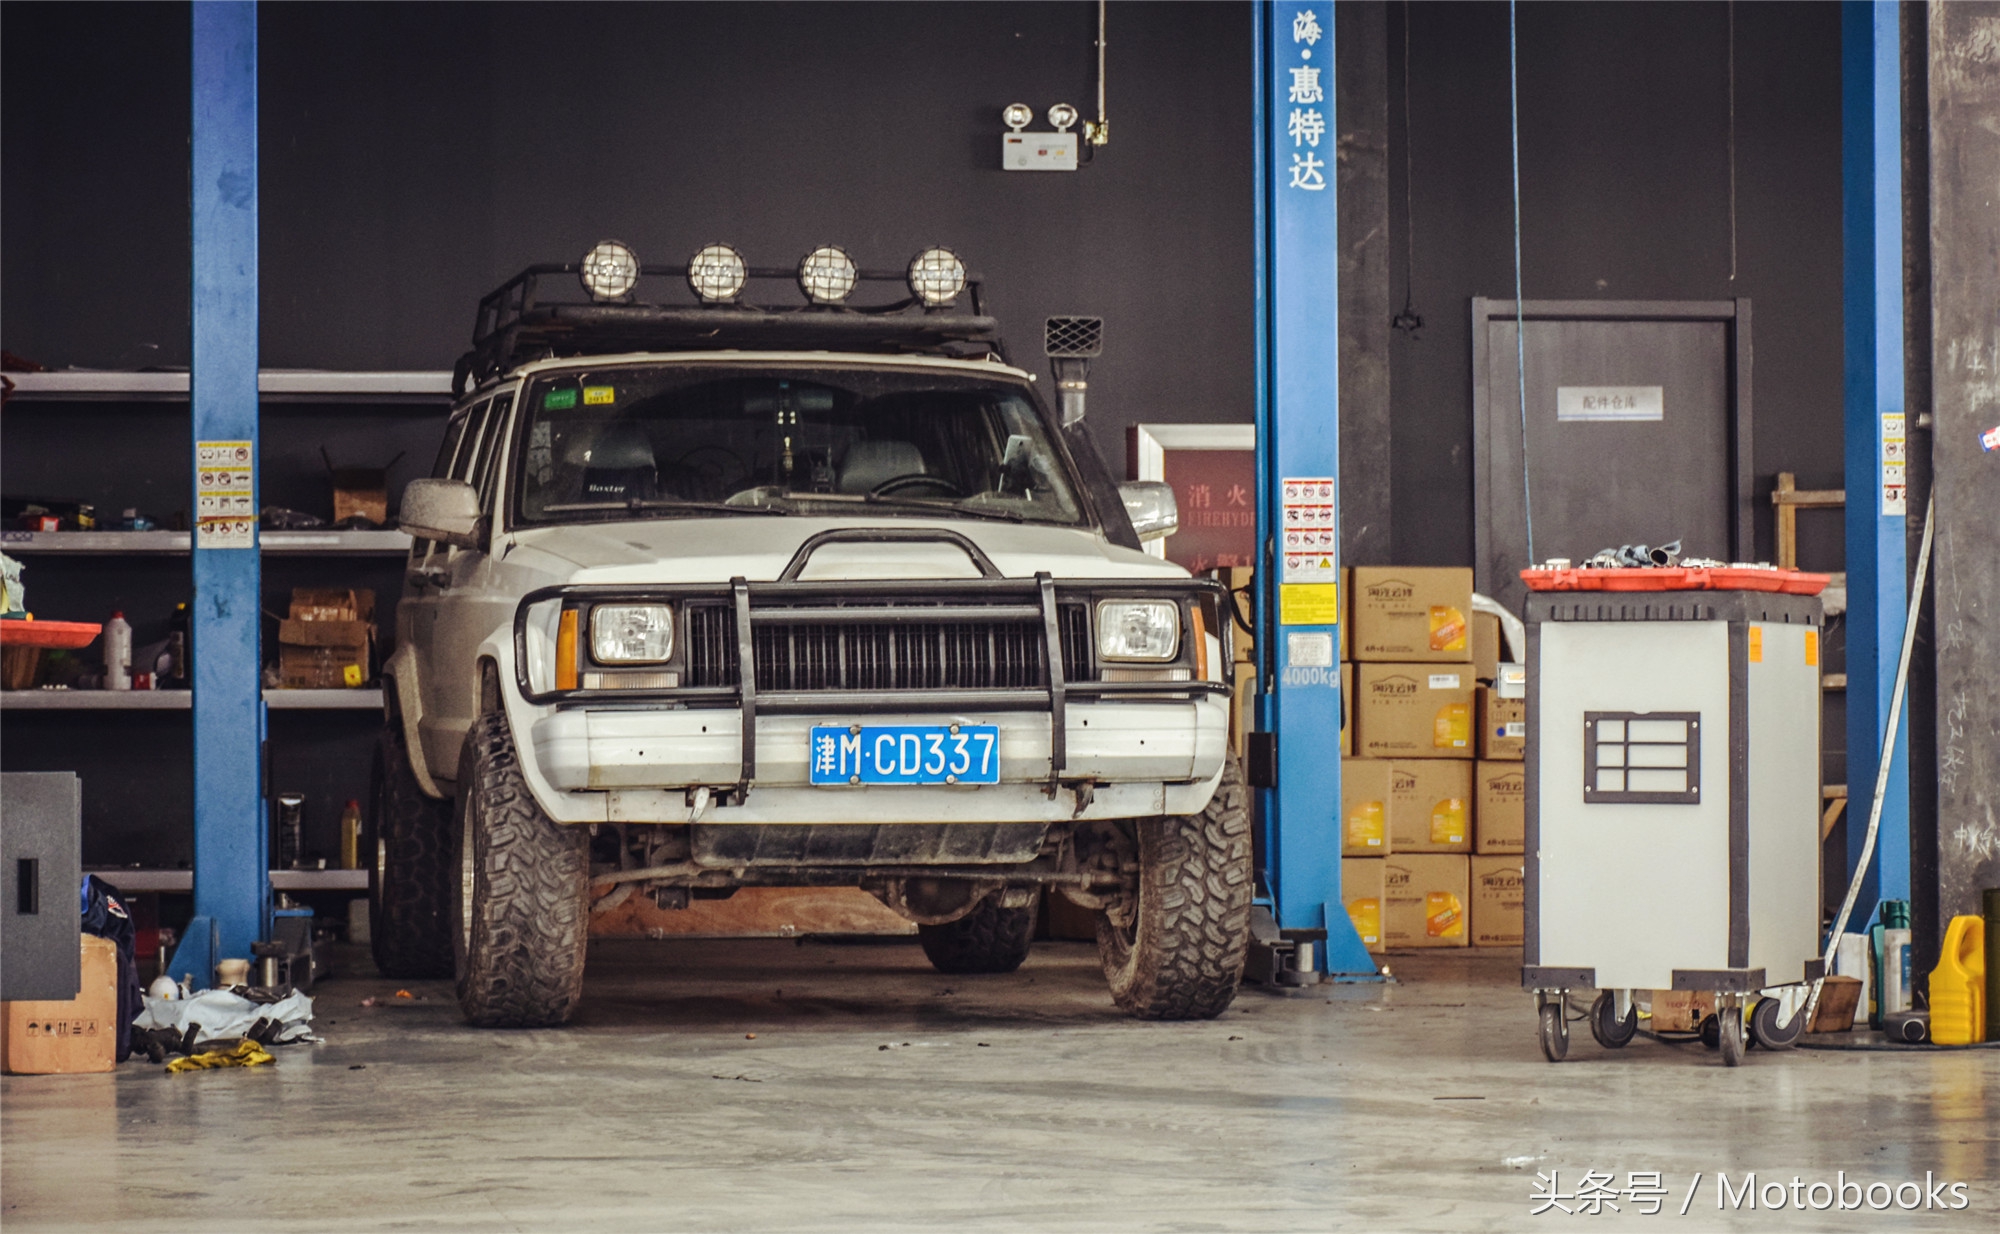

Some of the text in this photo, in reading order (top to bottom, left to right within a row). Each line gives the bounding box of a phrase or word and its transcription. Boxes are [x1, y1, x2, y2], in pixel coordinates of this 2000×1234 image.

[1582, 395, 1637, 410] 配件仓库
[1282, 667, 1338, 688] 4000kg
[815, 733, 995, 776] 津M·CD337
